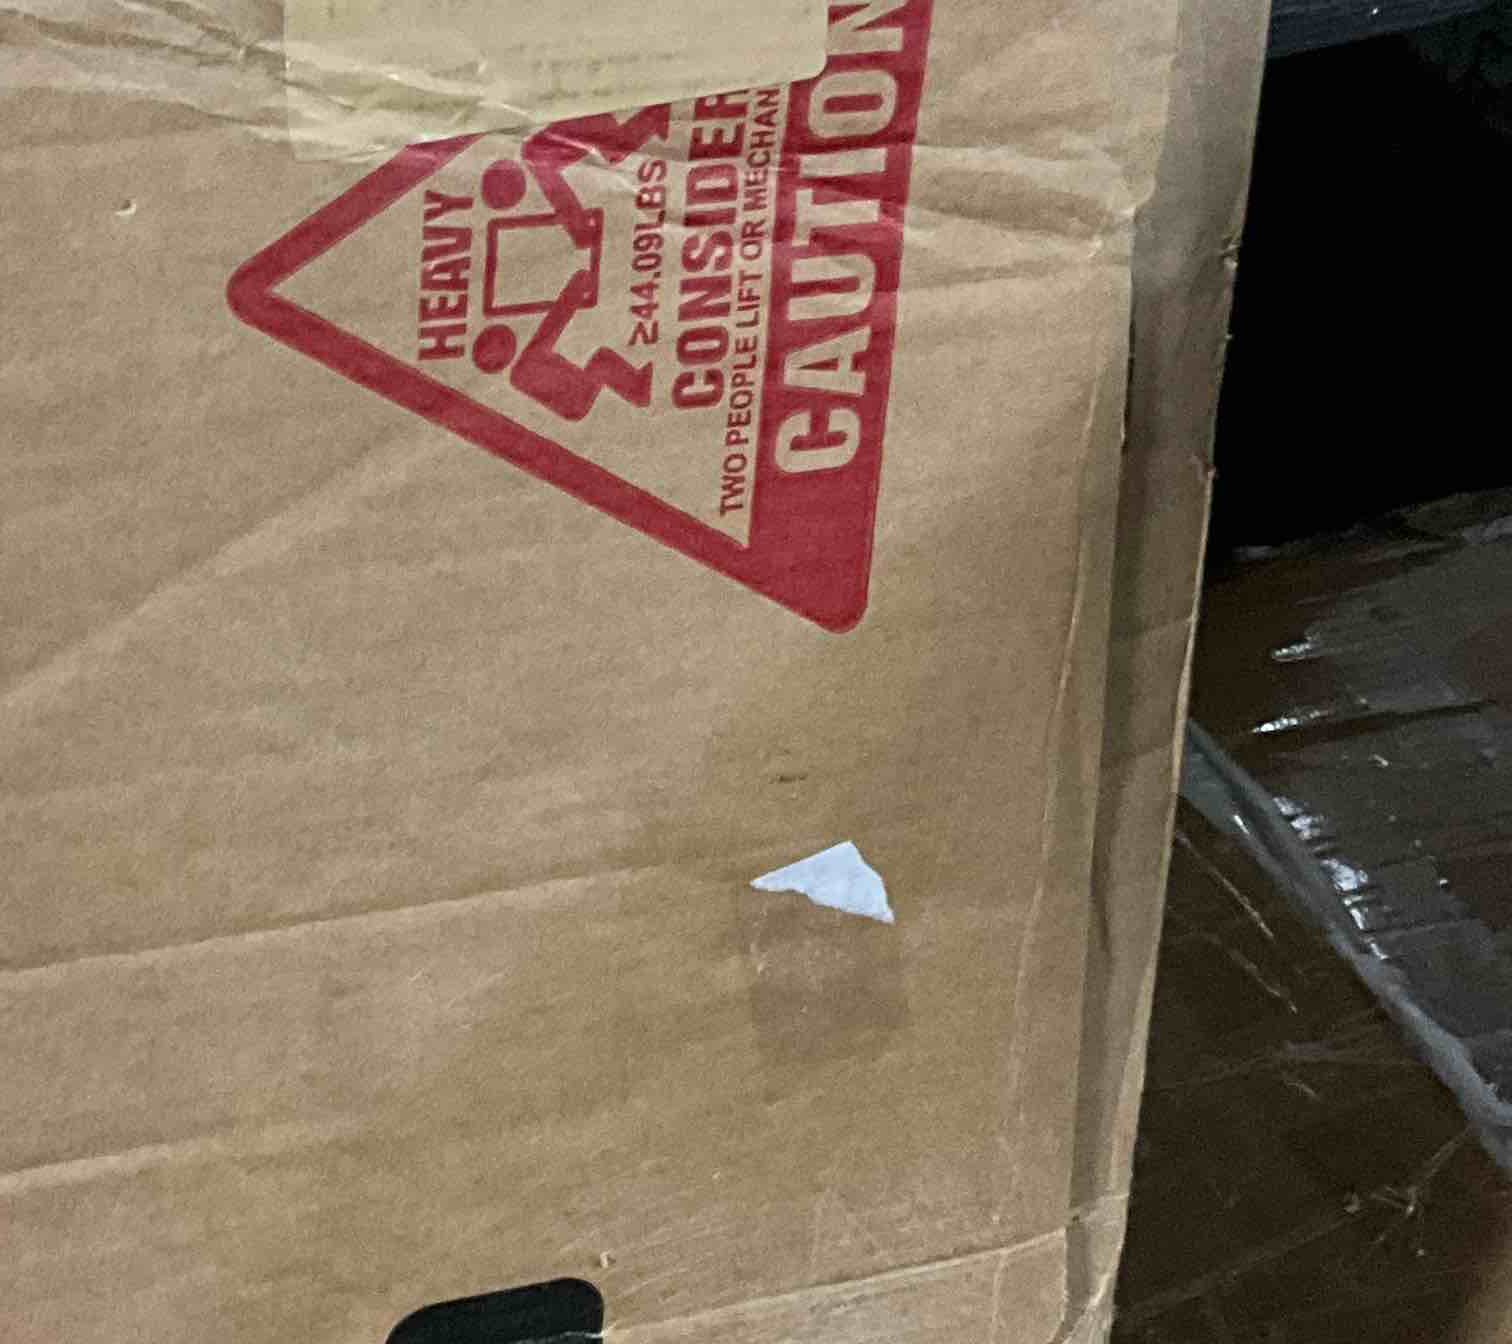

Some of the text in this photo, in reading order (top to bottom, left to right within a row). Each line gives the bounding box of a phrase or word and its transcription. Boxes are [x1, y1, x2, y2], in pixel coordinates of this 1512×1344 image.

[740, 220, 765, 261] OR
[417, 189, 474, 360] HEAVY
[735, 269, 763, 328] LIFT
[726, 335, 757, 446] PEOPLE
[720, 452, 748, 517] TWO
